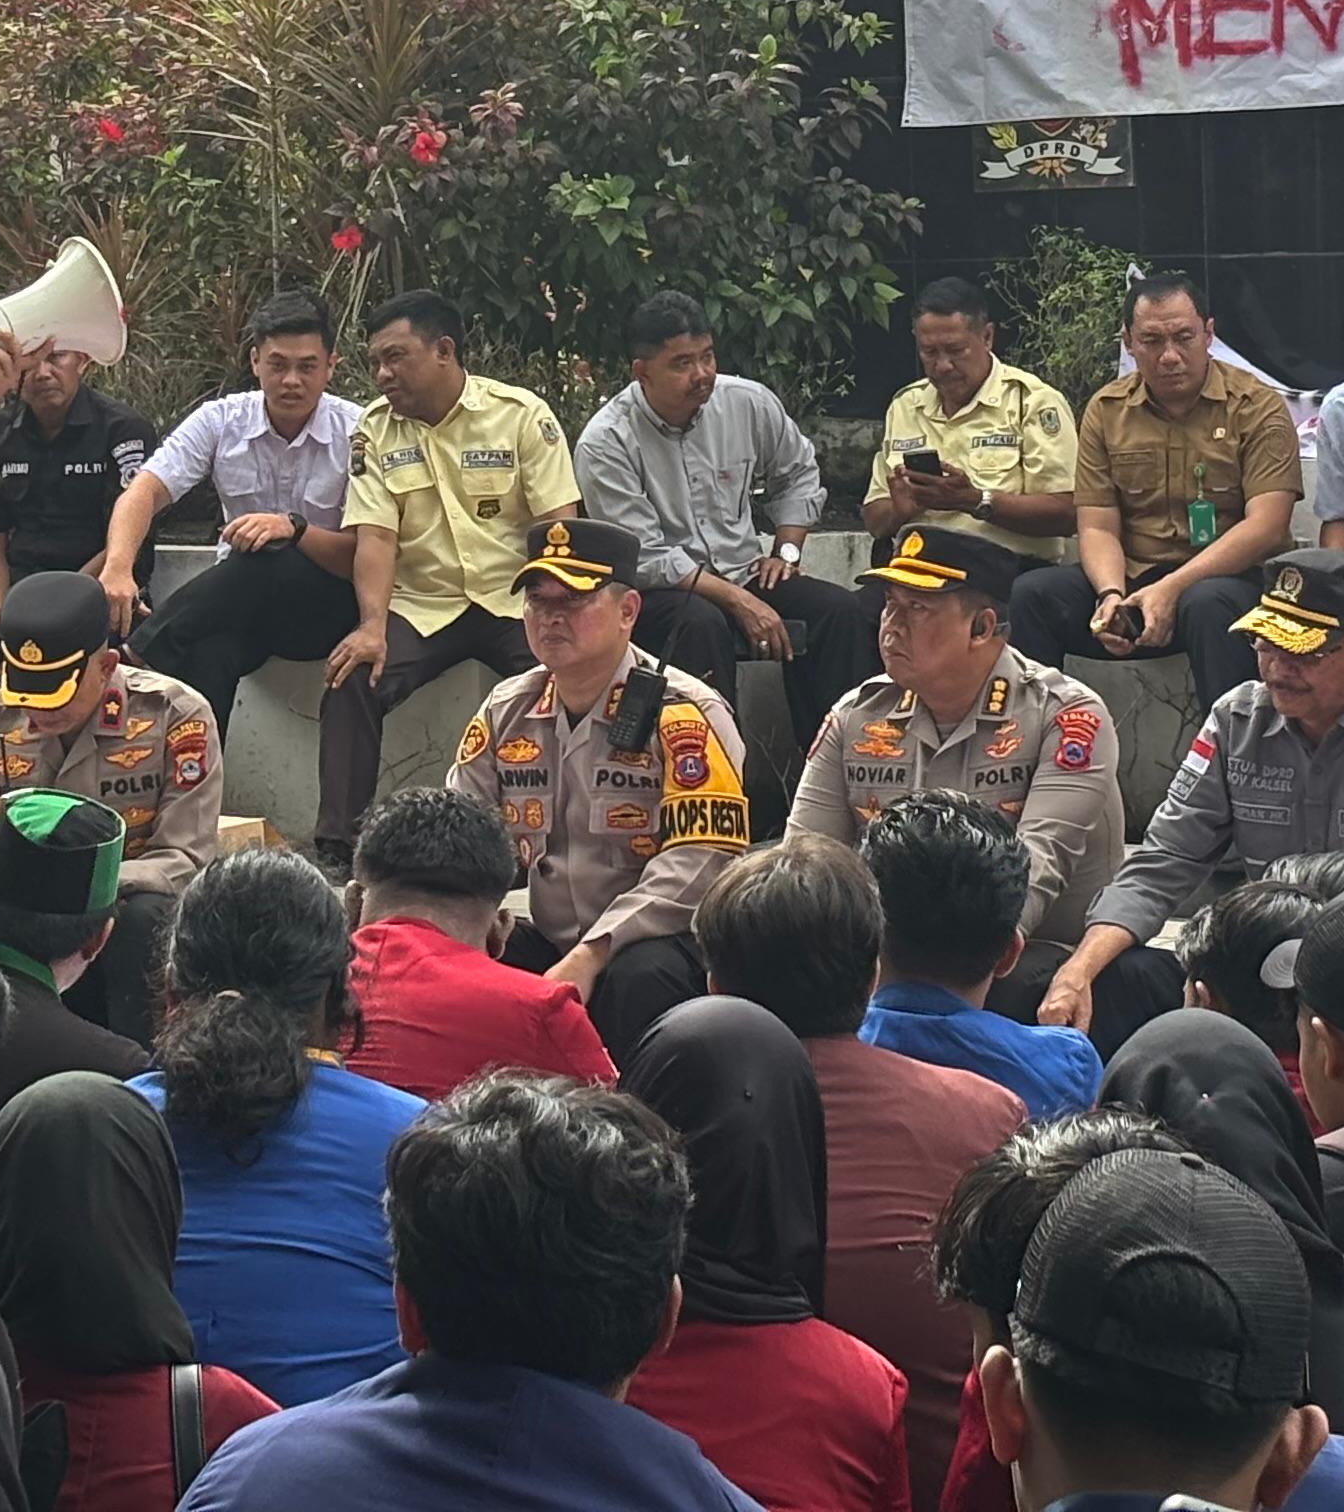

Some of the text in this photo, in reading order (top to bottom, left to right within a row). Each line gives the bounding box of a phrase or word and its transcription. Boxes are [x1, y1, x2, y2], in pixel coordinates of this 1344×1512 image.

[1023, 142, 1082, 159] DPRD
[99, 773, 162, 797] POLRI
[846, 765, 906, 785] NOVIAR
